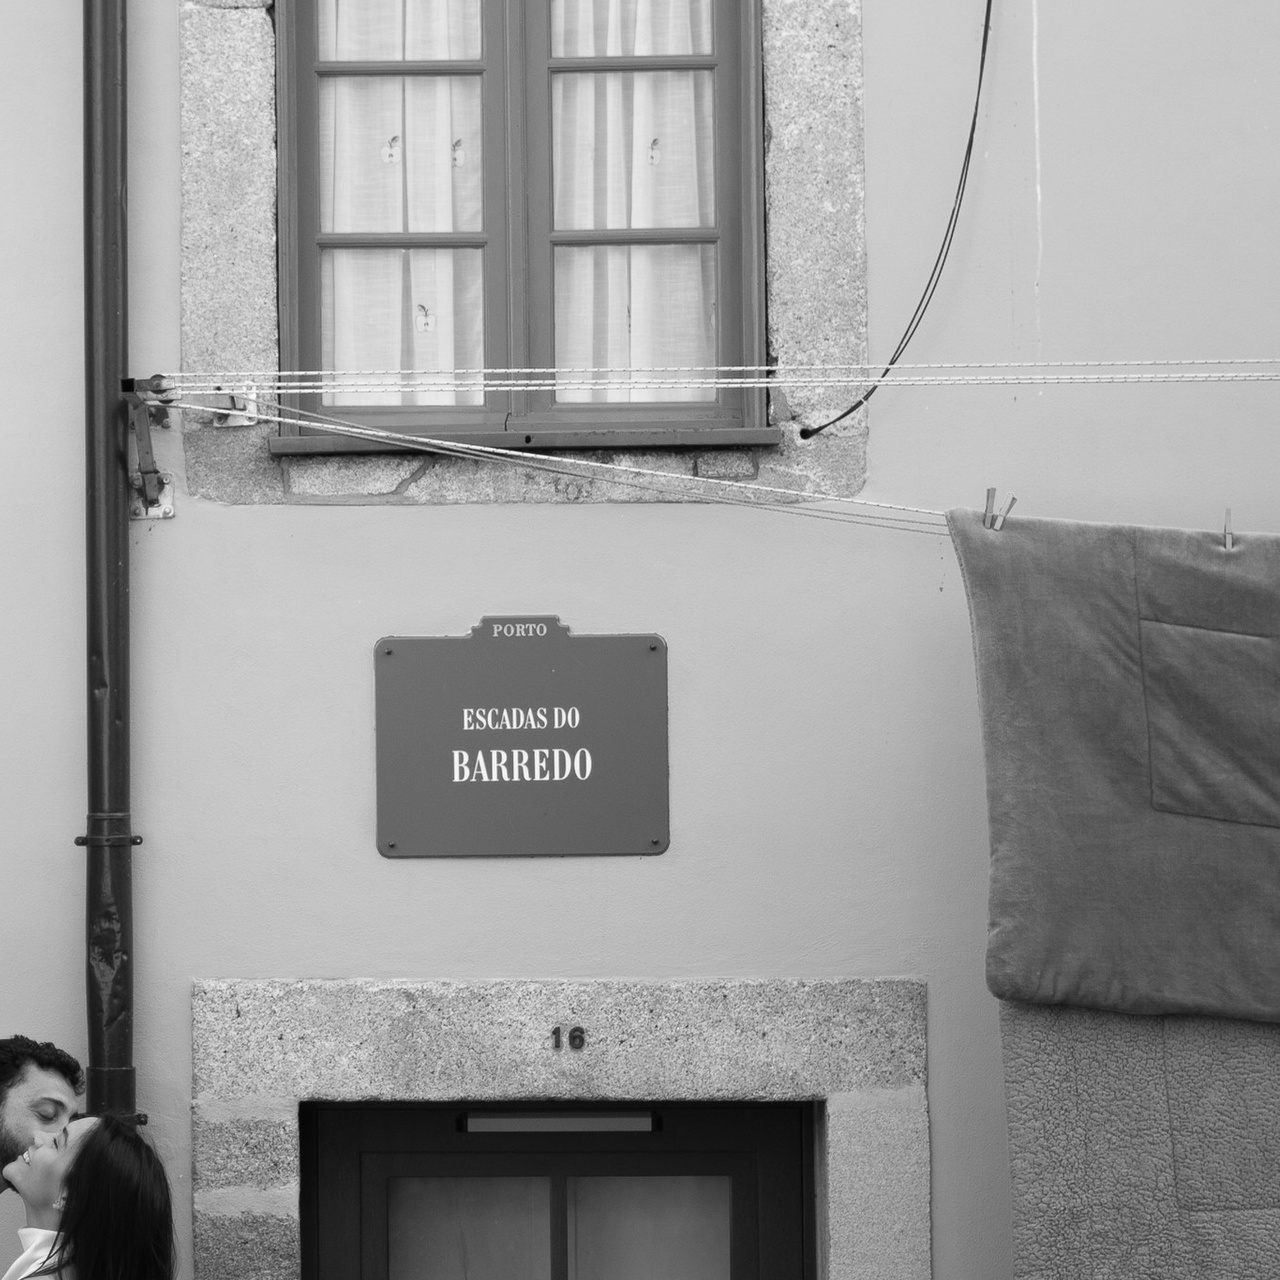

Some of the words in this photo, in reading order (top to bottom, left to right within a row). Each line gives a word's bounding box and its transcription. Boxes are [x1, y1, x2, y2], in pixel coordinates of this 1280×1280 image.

[492, 623, 548, 637] PORTO
[462, 707, 548, 731] ESCADAS
[553, 706, 580, 729] DO
[452, 748, 593, 783] BARREDO
[551, 1026, 585, 1050] 16
